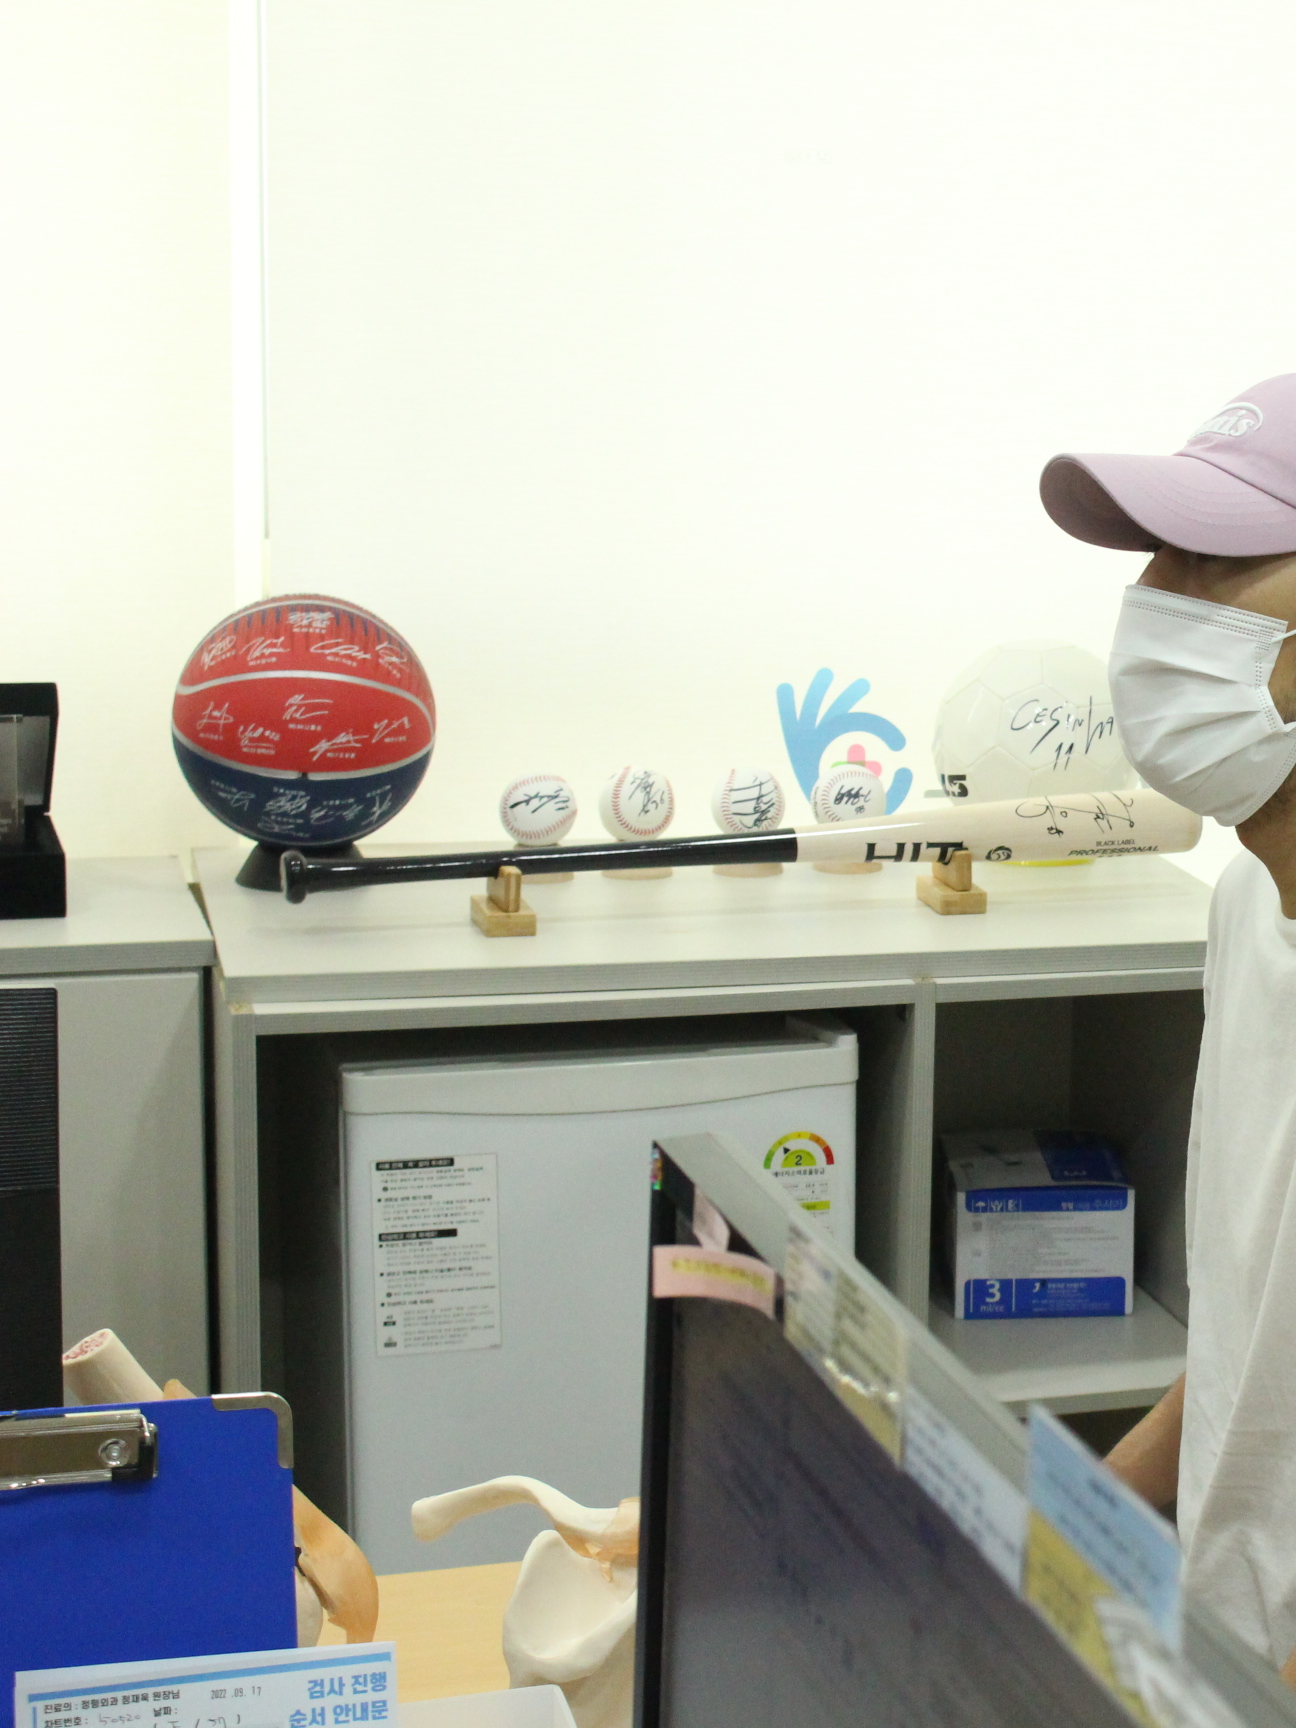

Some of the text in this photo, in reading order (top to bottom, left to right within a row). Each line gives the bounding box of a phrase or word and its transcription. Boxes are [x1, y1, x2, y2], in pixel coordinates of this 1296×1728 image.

[1067, 845, 1160, 857] PROFESSIONAL
[794, 1154, 803, 1166] 2
[986, 1280, 1002, 1304] 3
[211, 1688, 227, 1700] 2022
[307, 1671, 388, 1700] 검사 진행
[289, 1699, 389, 1728] 순서 안내문
